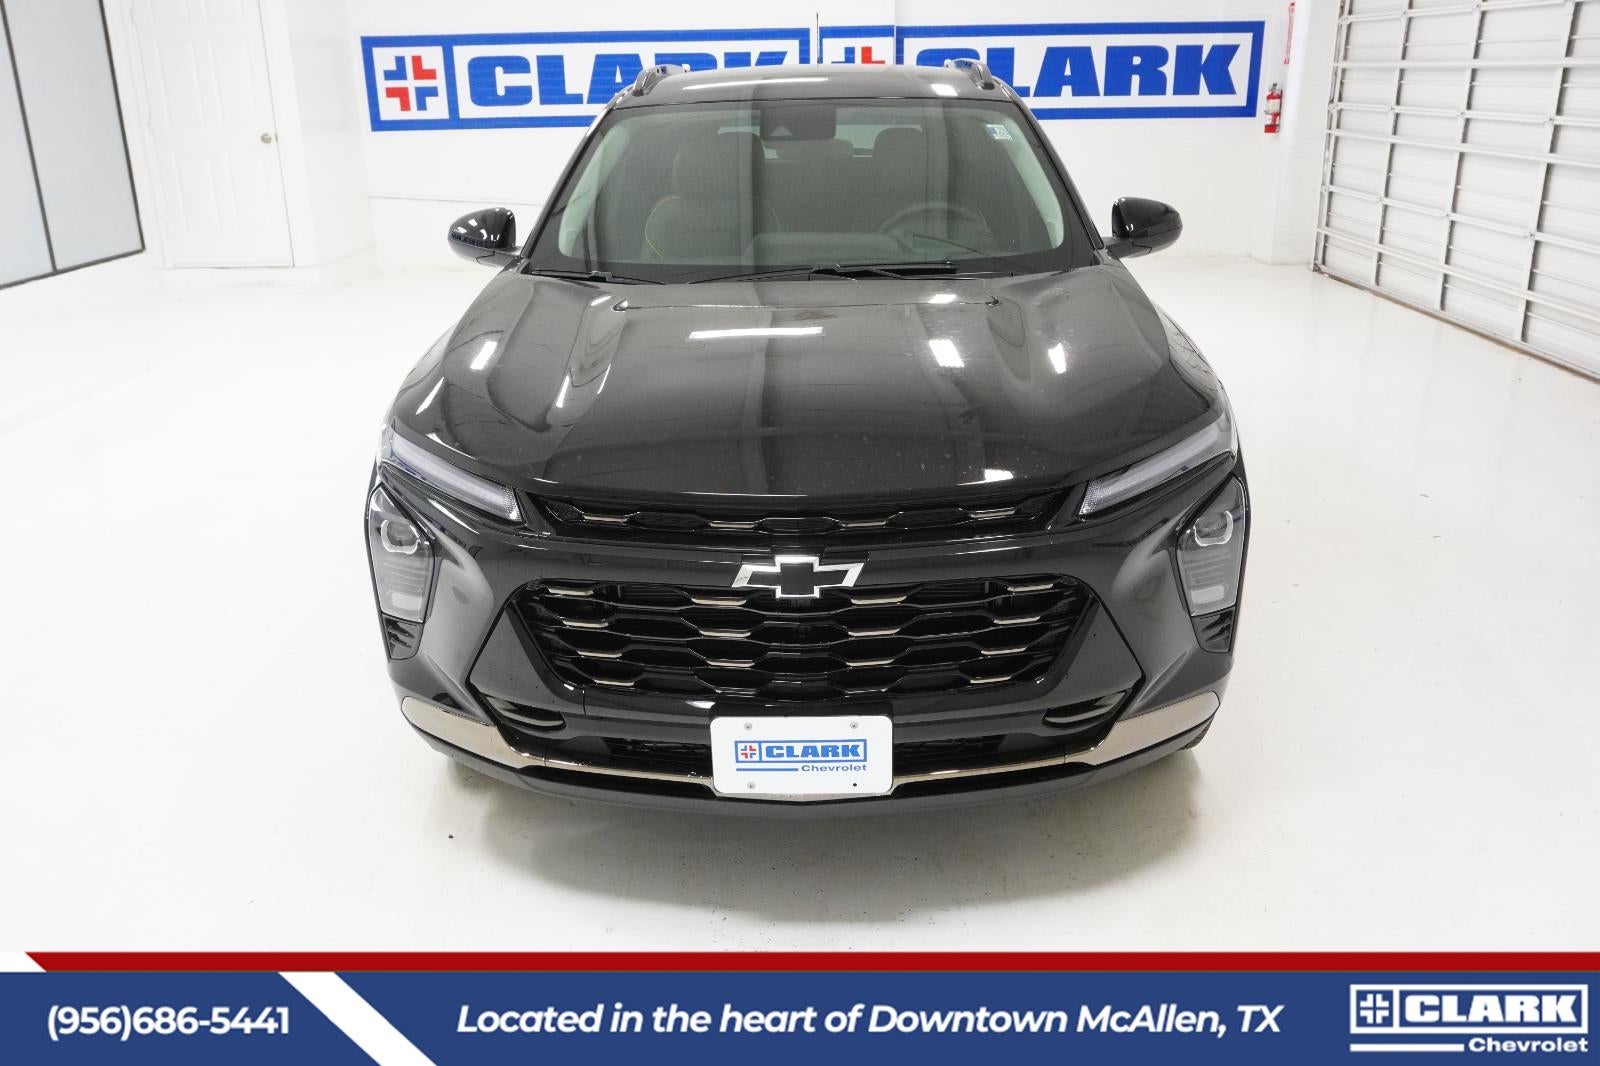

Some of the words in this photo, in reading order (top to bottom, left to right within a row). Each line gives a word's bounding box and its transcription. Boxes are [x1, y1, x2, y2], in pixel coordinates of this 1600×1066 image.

[467, 51, 787, 106] CLA
[765, 744, 860, 758] CLARK
[801, 764, 867, 772] Chevrolet
